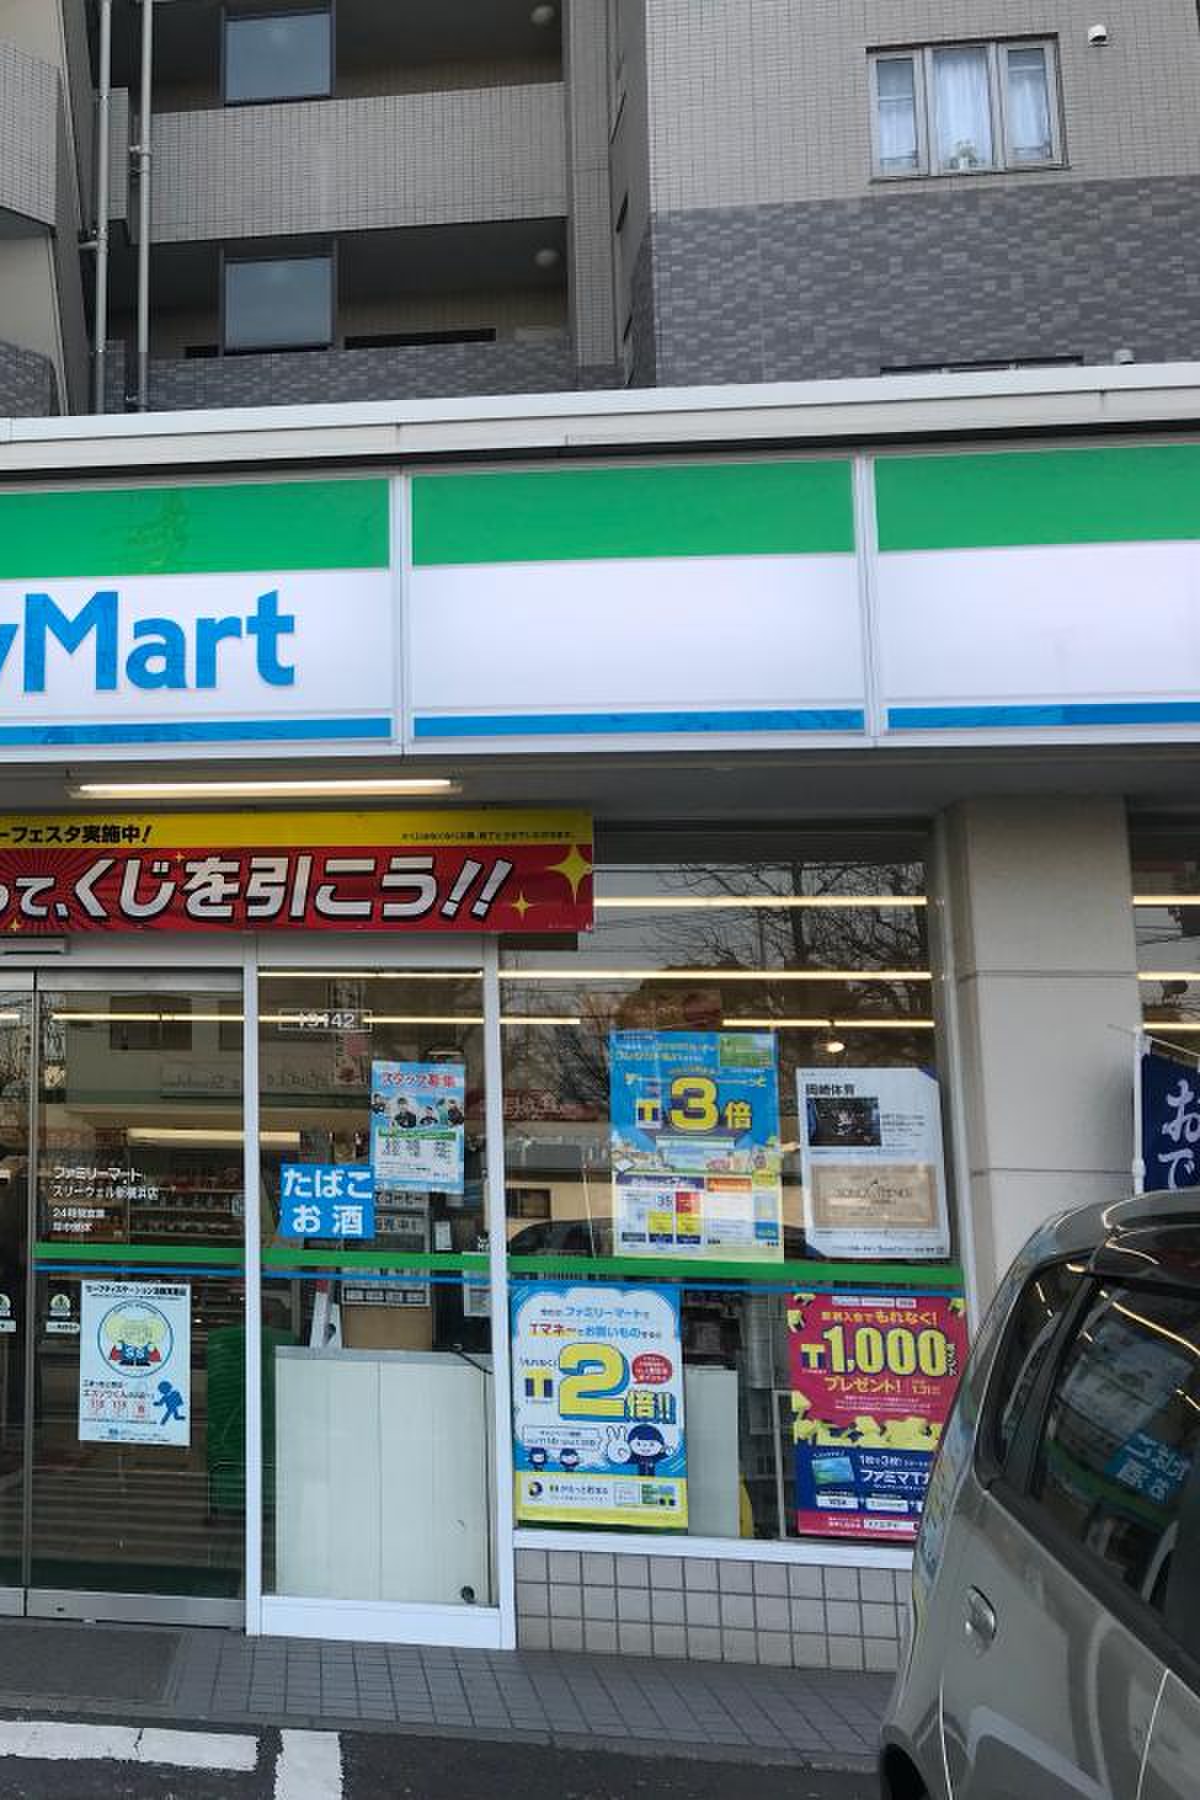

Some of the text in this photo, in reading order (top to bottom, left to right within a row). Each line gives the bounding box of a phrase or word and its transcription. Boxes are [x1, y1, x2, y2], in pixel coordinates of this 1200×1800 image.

[54, 1167, 143, 1183] ファミリーマート
[284, 1168, 373, 1199] たばこ
[293, 1204, 364, 1236] お酒
